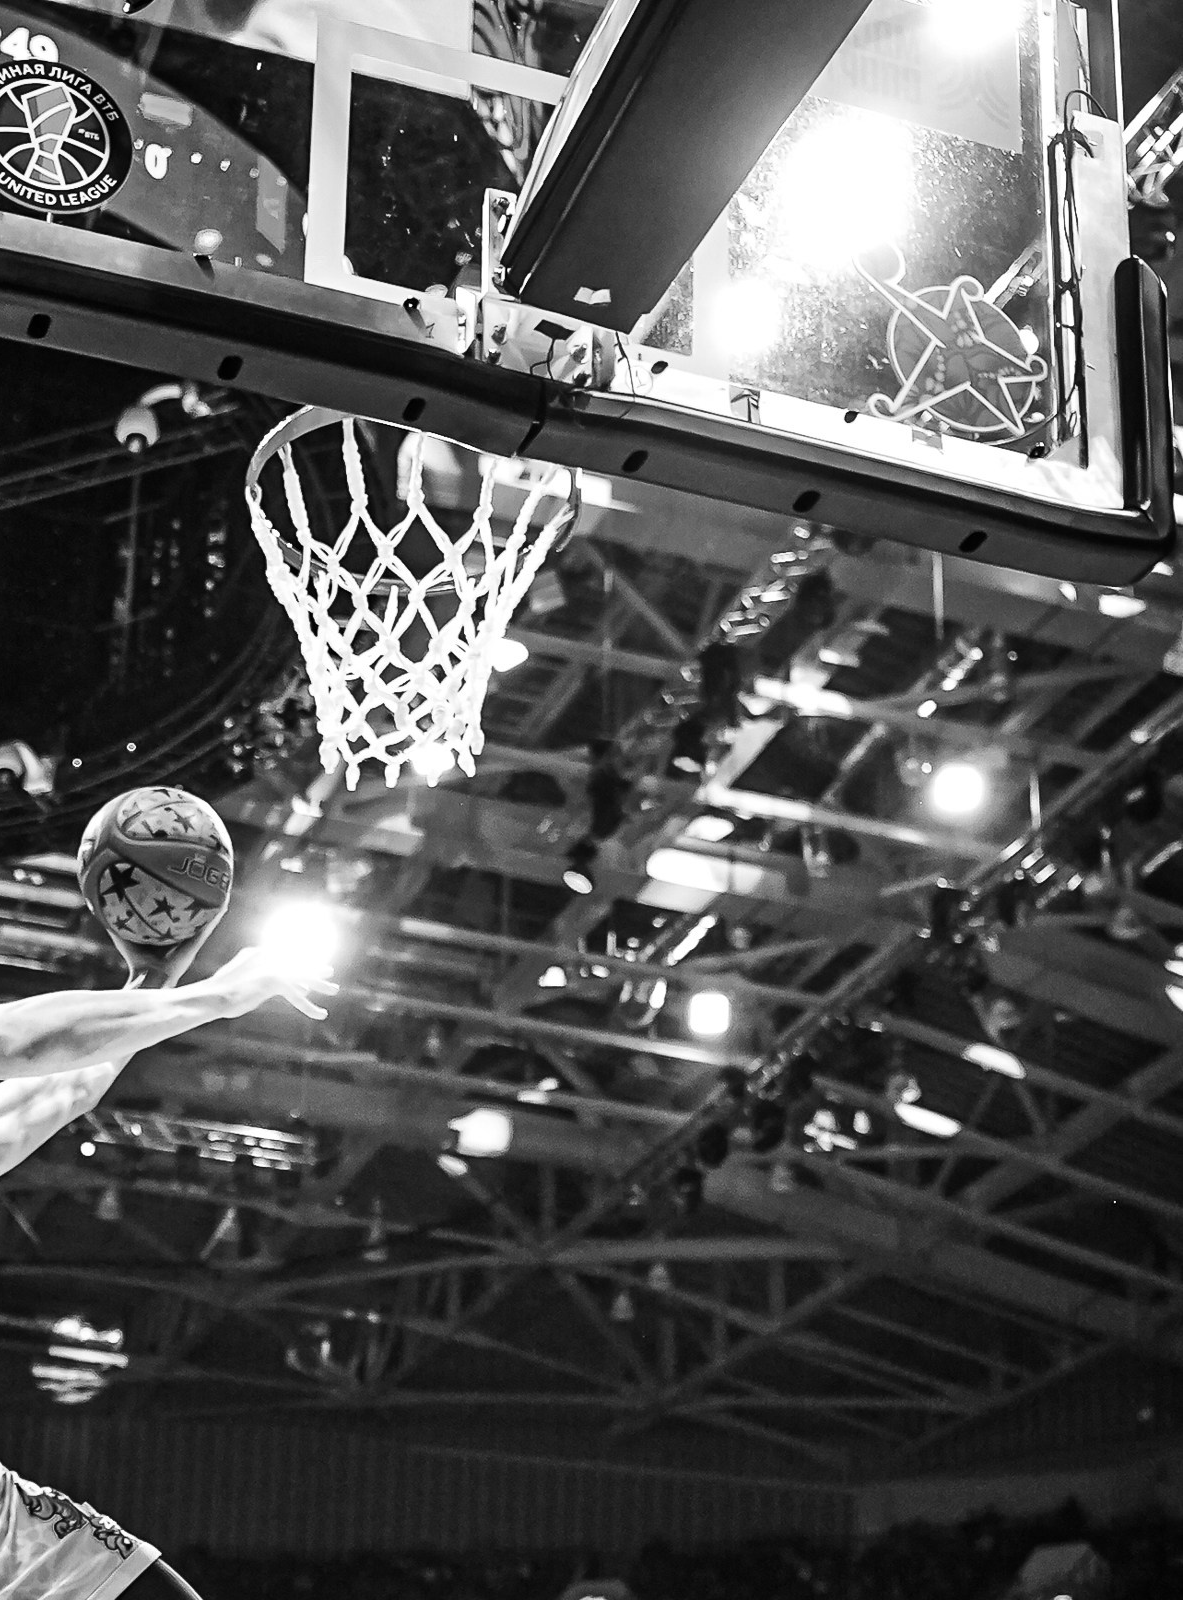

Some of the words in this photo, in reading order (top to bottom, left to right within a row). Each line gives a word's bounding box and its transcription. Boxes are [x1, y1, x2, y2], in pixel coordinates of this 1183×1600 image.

[48, 66, 92, 96] ЛИГА
[92, 94, 119, 122] ВТБ
[59, 173, 118, 207] LEAGUE
